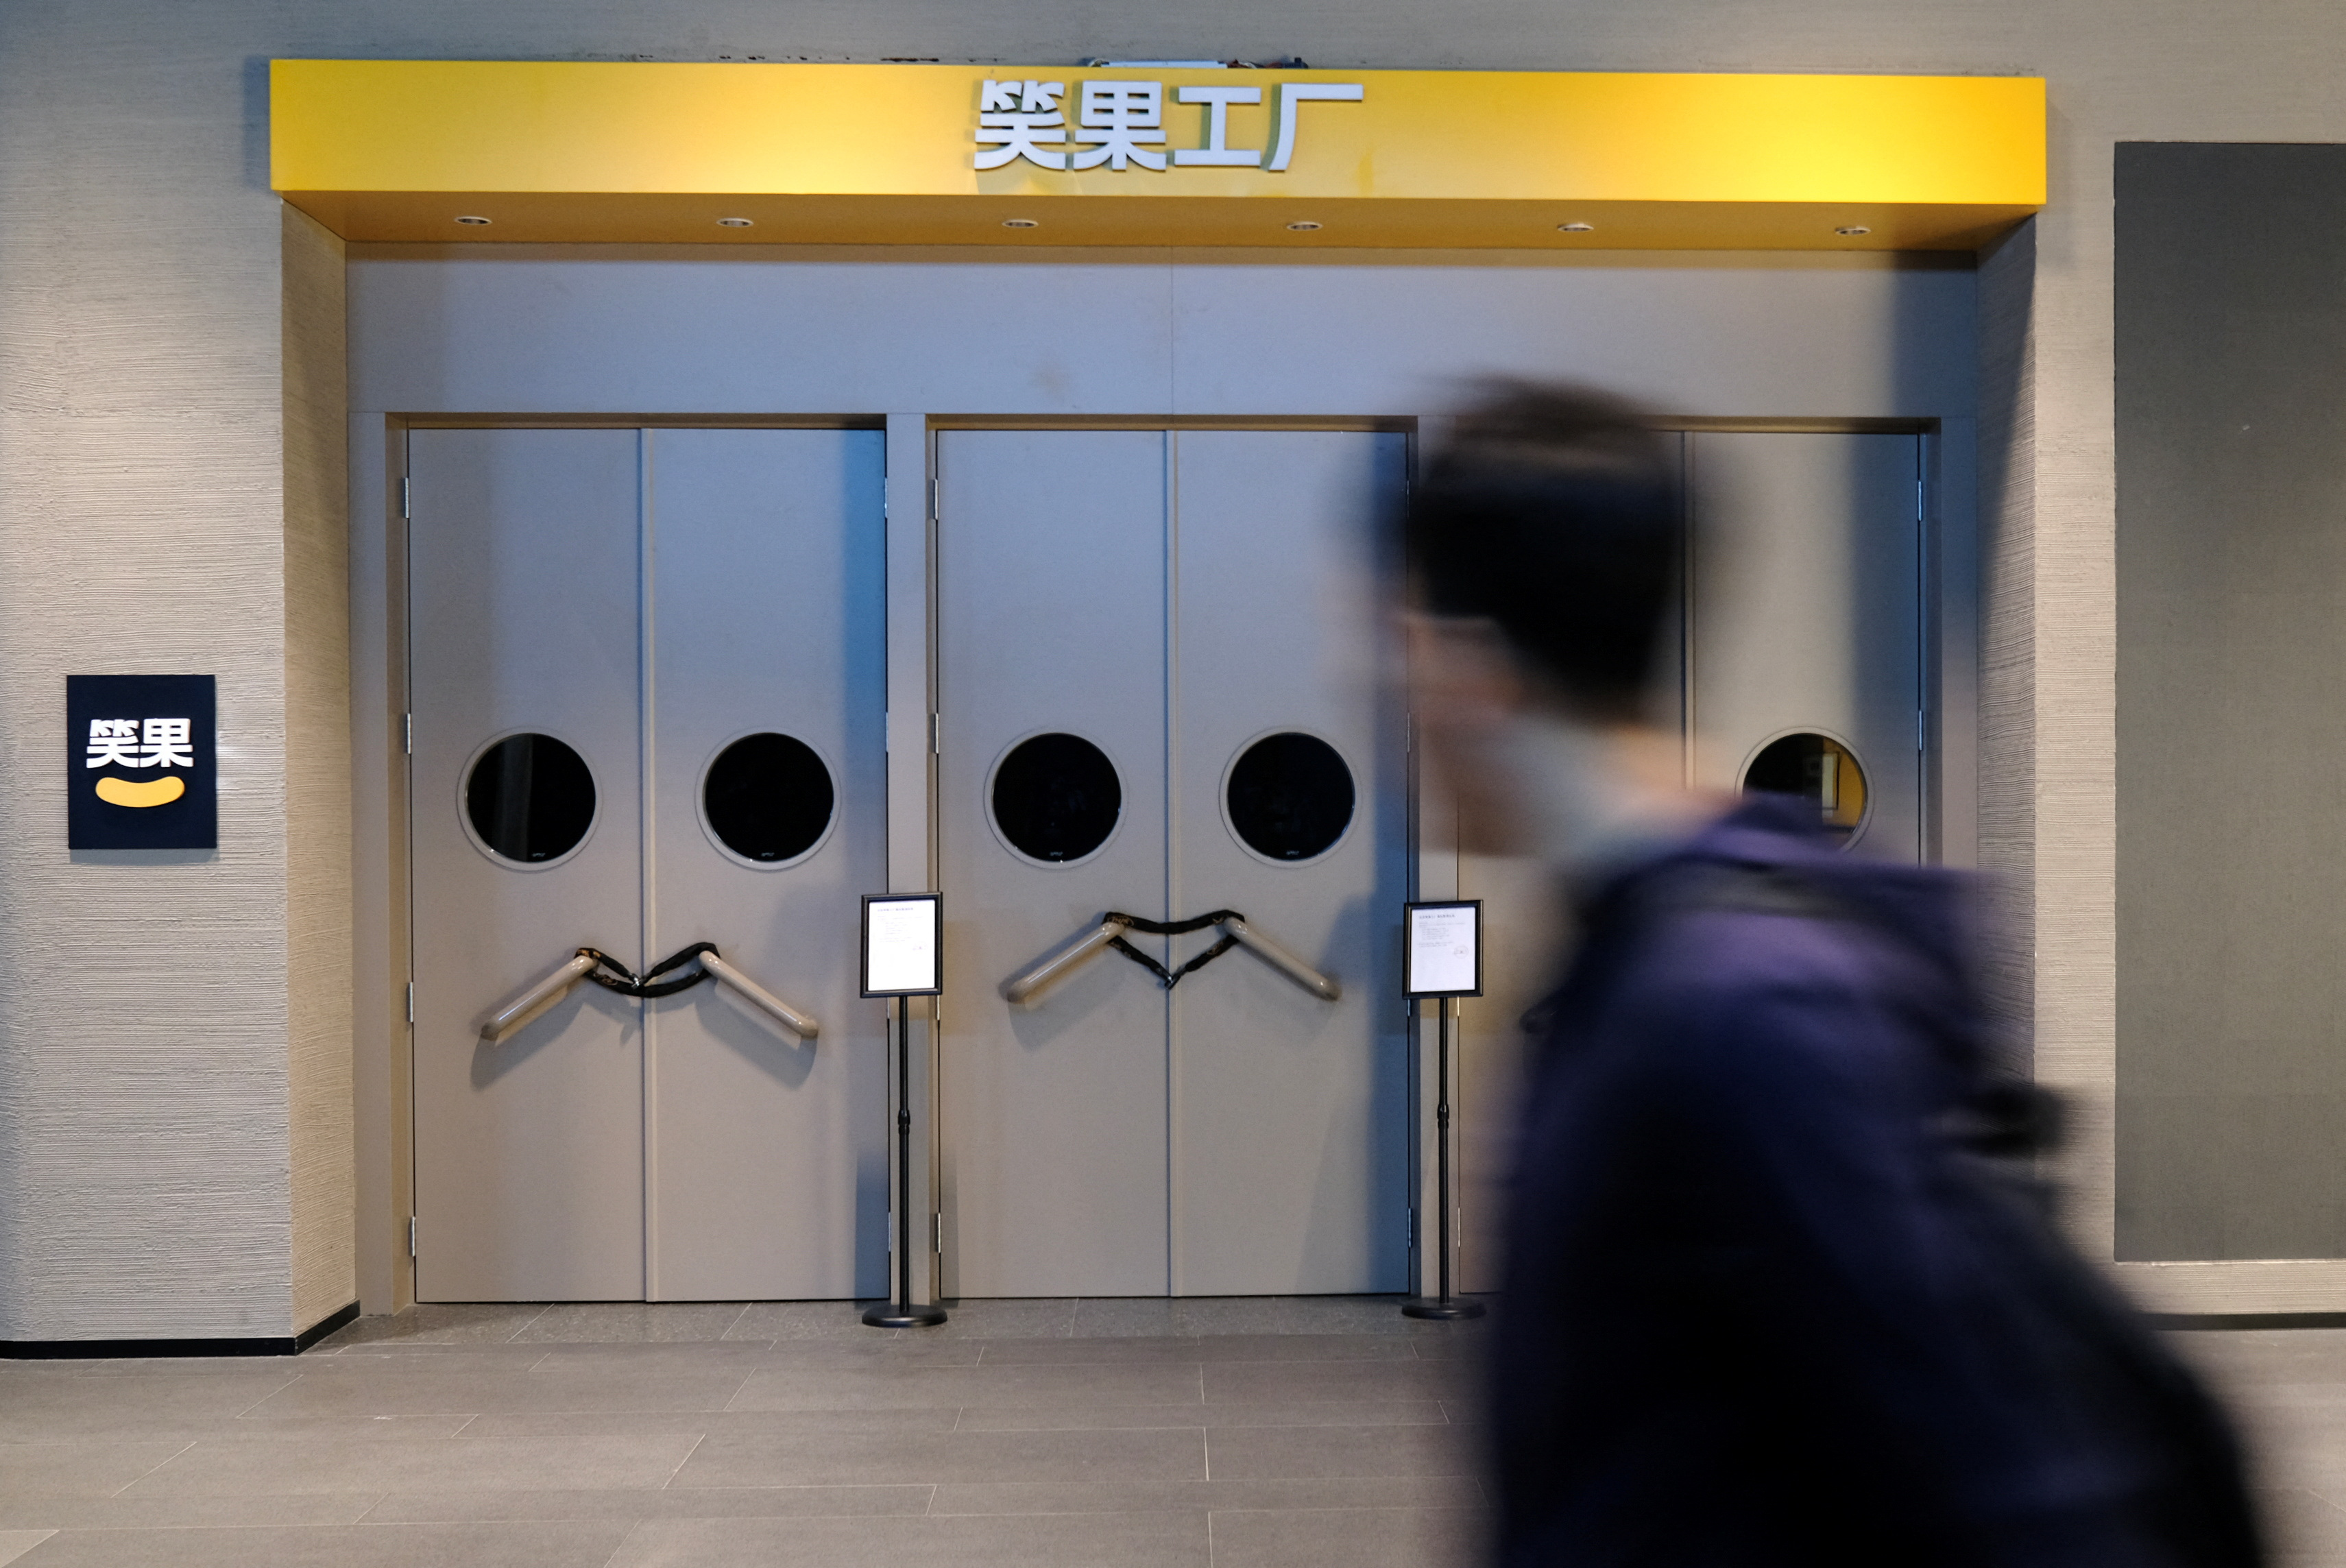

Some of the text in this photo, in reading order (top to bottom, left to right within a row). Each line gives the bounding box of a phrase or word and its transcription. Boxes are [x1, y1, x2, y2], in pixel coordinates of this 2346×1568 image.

[974, 79, 1364, 172] 笑果工厂
[86, 717, 194, 769] 笑果
